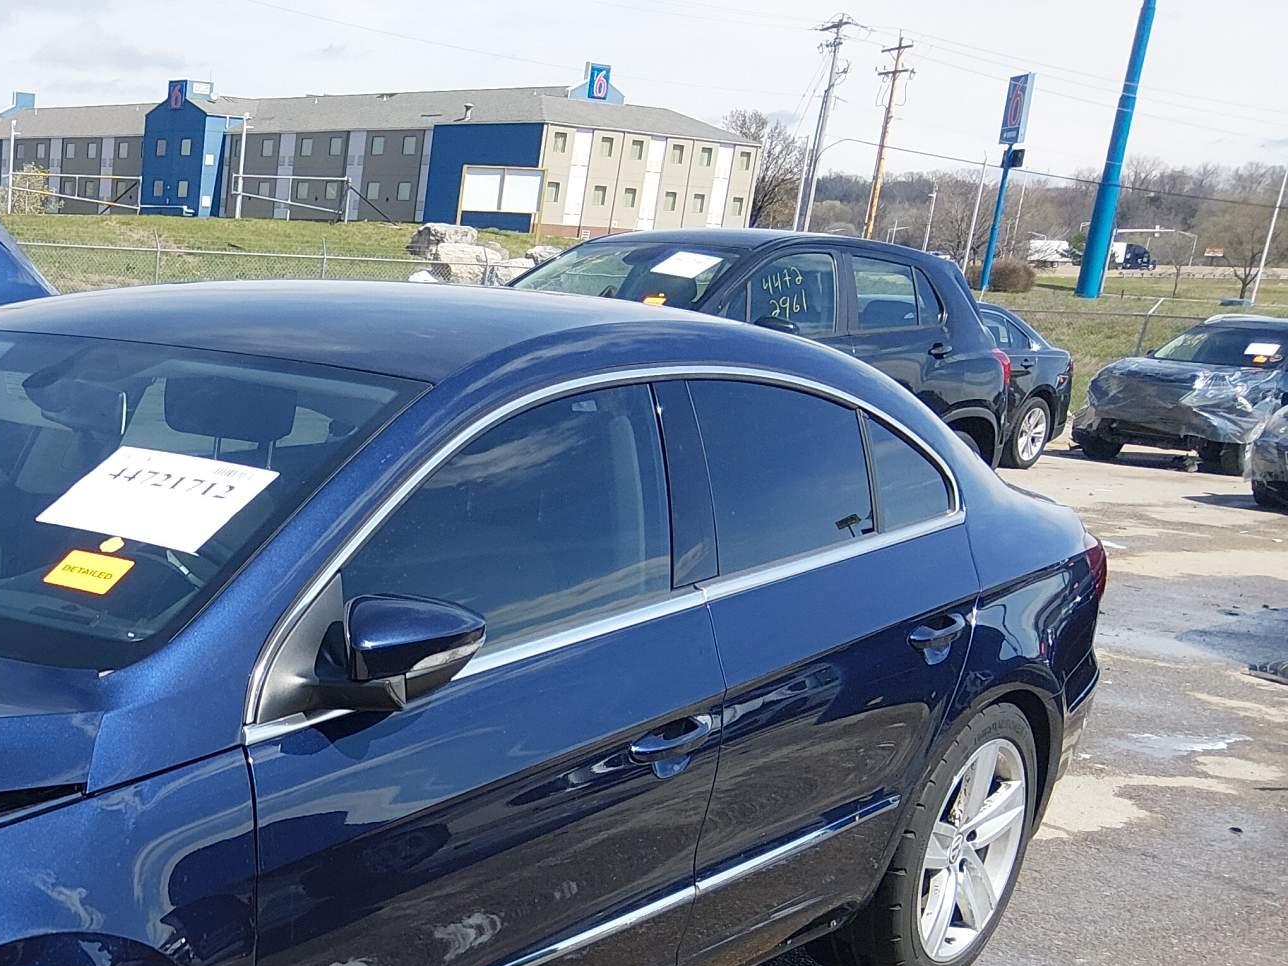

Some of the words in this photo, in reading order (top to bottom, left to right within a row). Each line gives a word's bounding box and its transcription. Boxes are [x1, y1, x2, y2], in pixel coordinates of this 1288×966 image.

[593, 69, 608, 98] 6
[1008, 77, 1025, 129] 6
[762, 266, 803, 295] 4472
[769, 288, 808, 320] 2961
[108, 467, 235, 499] 44721712
[62, 564, 113, 580] DETAILED
